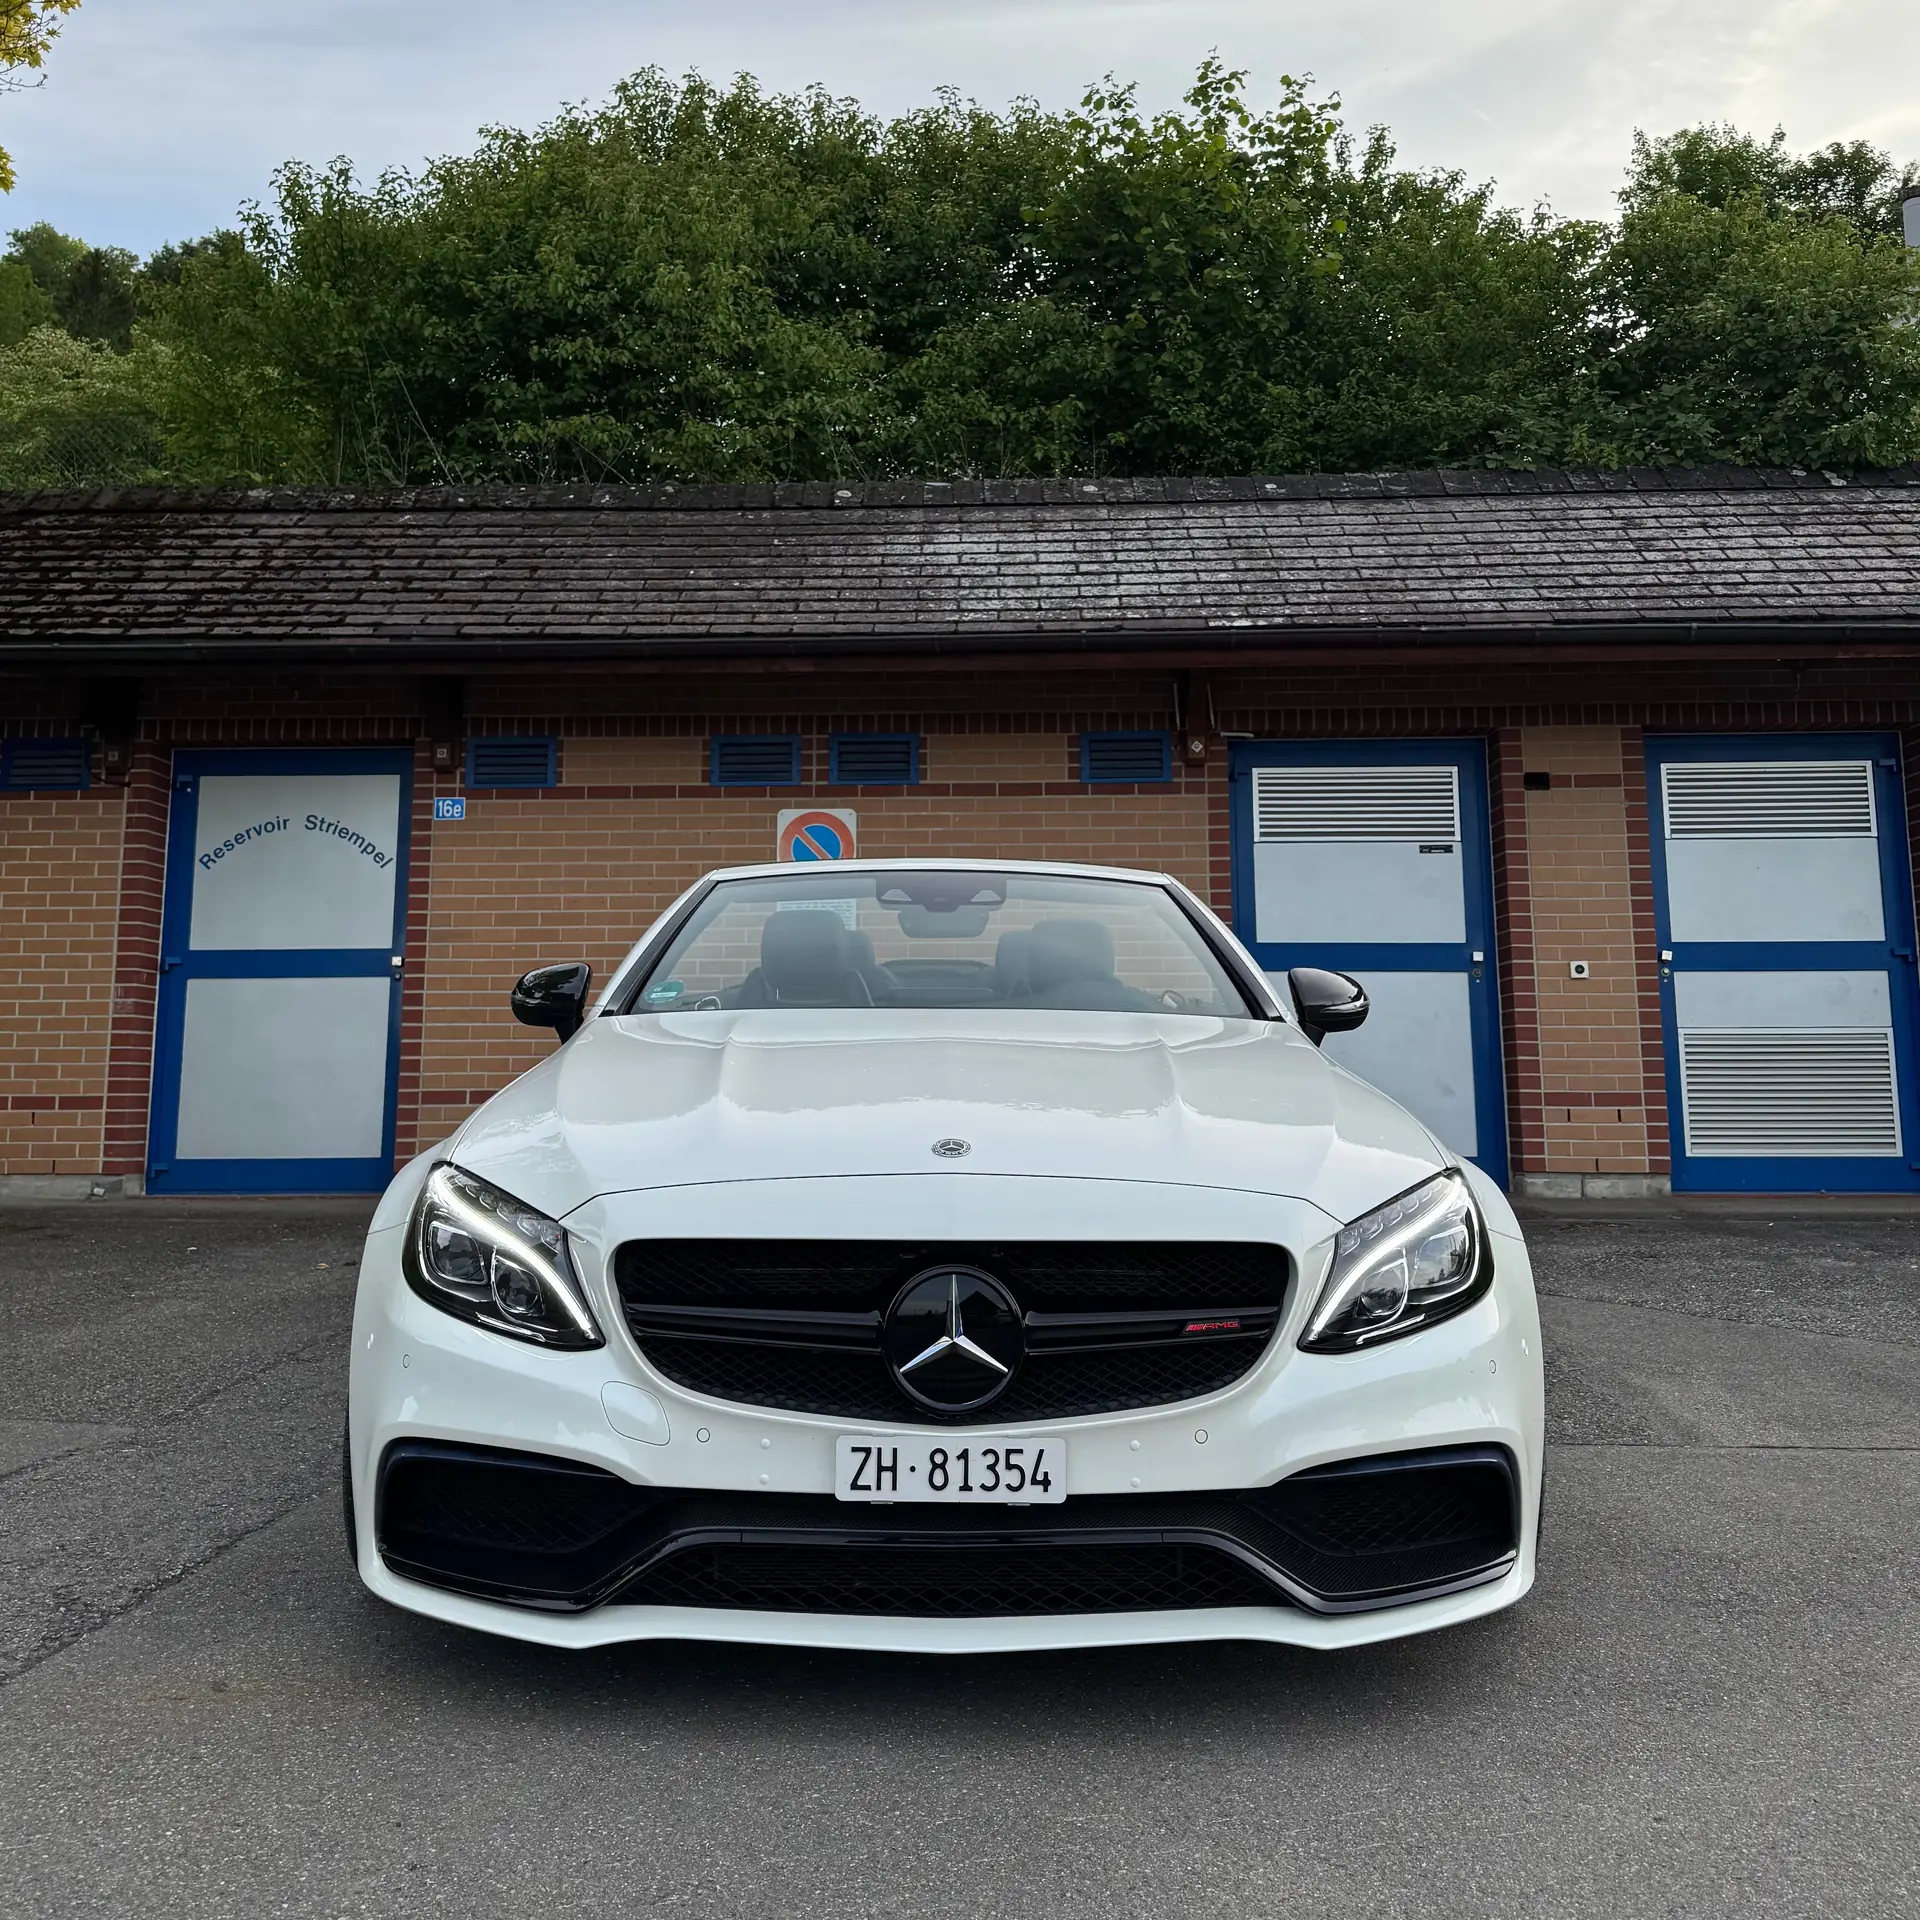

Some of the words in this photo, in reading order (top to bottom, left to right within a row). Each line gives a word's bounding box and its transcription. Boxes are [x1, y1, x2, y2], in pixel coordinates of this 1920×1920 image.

[438, 800, 462, 817] 16e
[199, 816, 290, 870] Reservoir
[304, 814, 394, 869] Striempel
[1202, 1321, 1239, 1330] AMG
